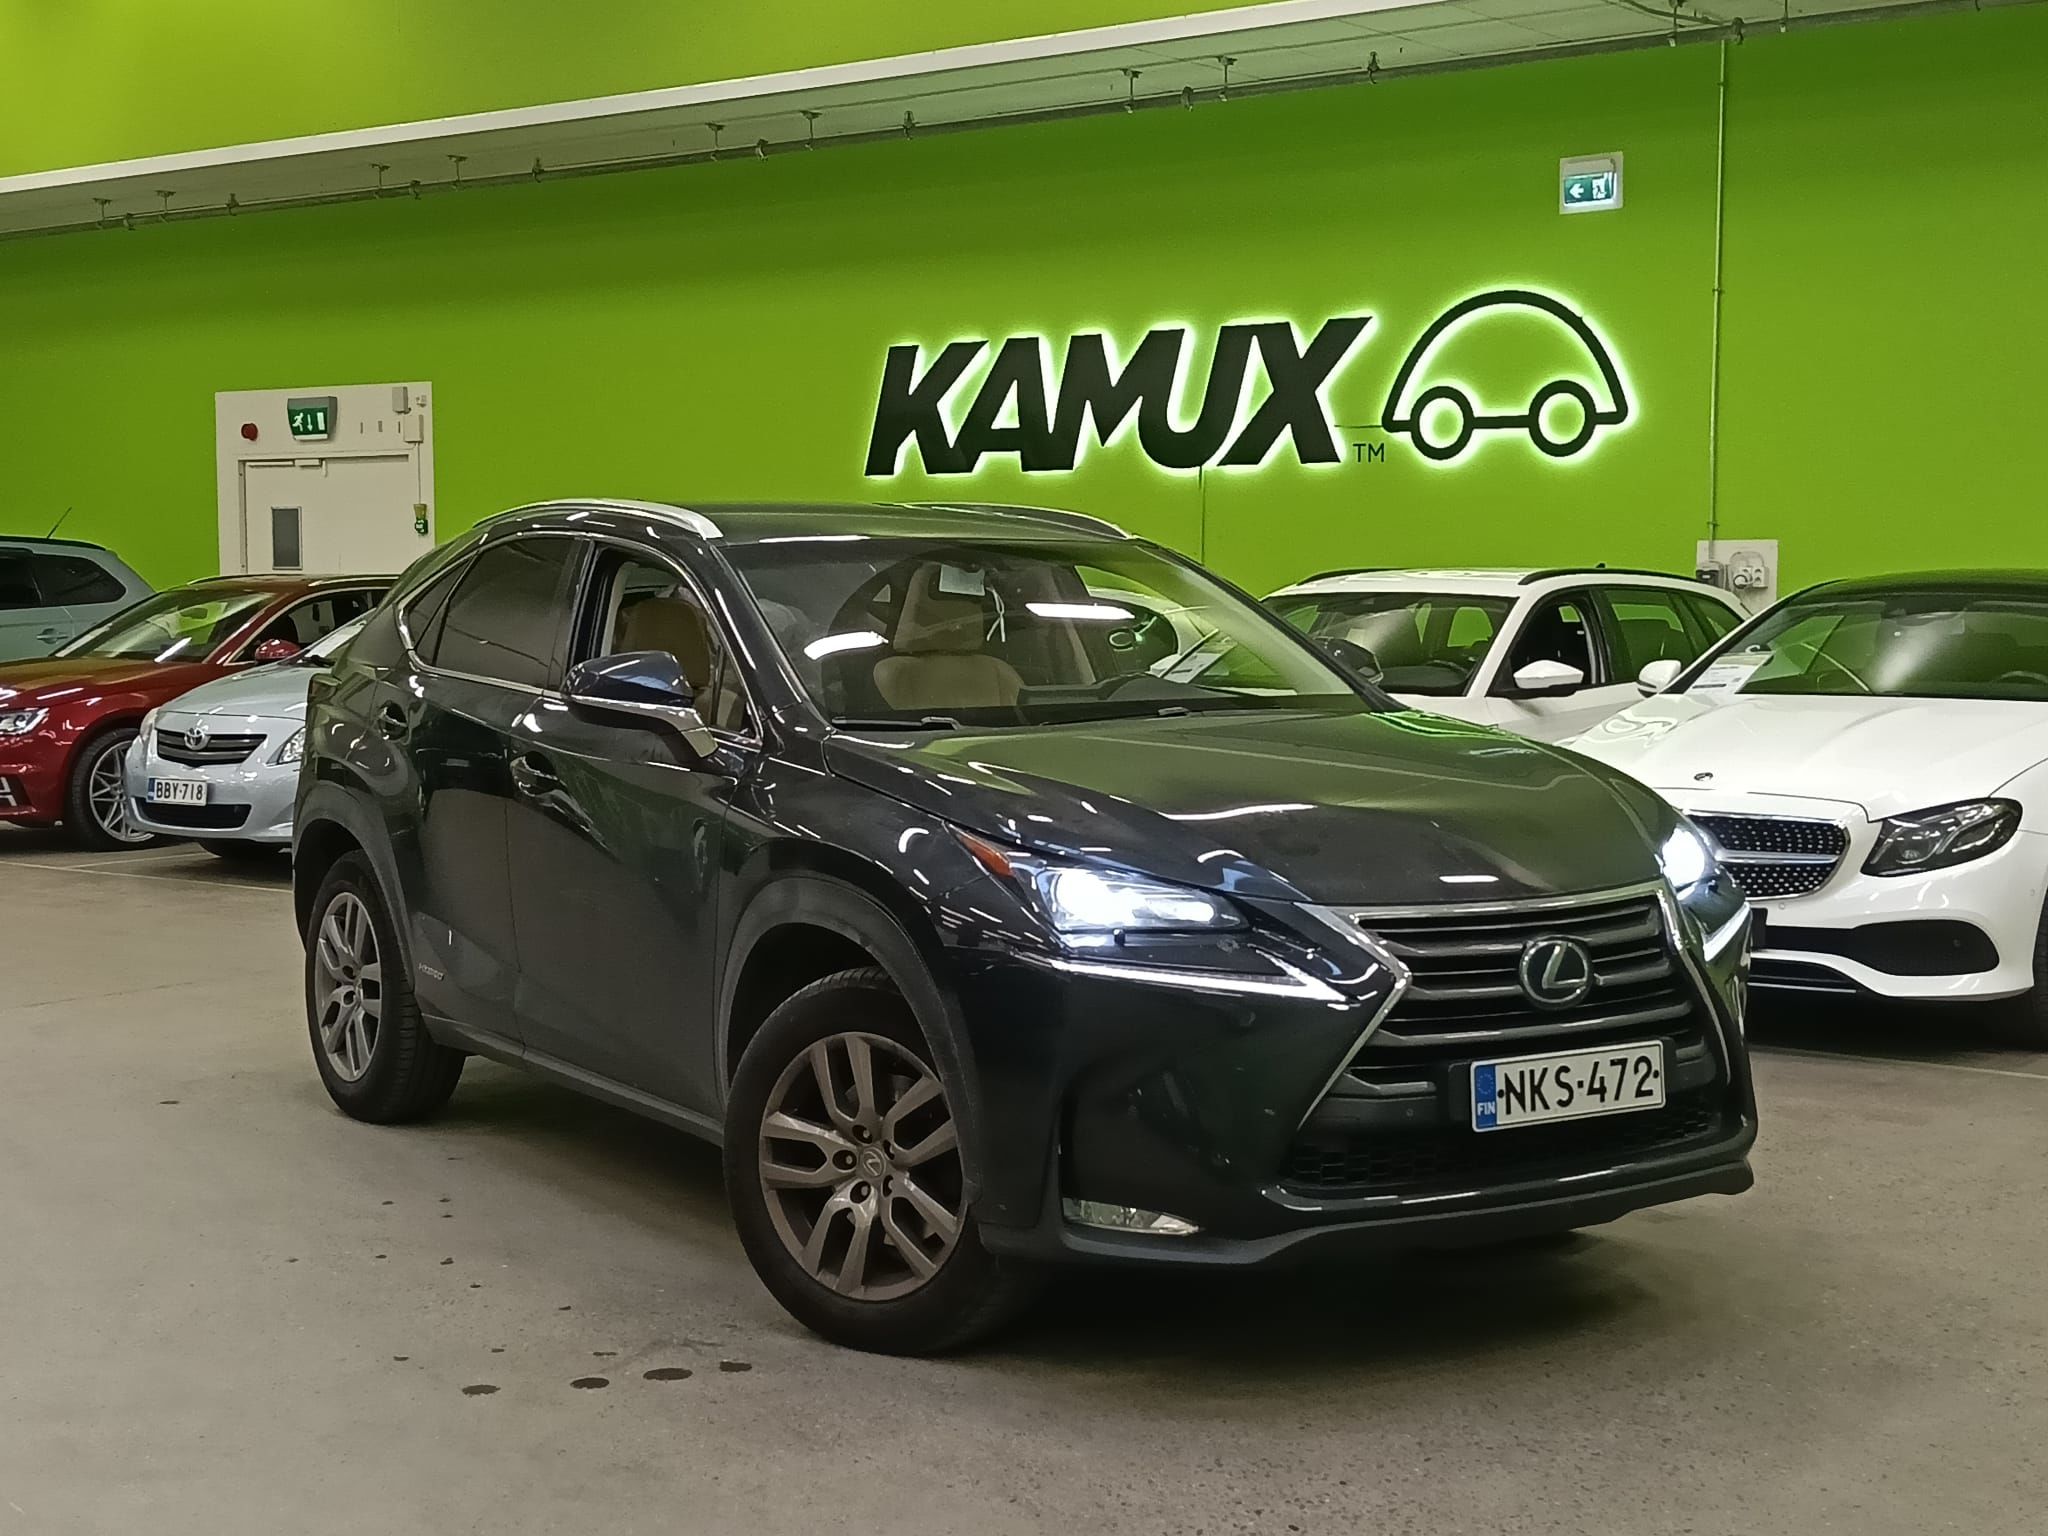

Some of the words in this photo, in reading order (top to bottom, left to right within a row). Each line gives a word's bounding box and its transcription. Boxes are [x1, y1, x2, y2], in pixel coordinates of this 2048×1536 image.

[864, 316, 1373, 476] KAMUX
[1352, 443, 1385, 463] TM
[156, 781, 204, 801] BBY-718
[1477, 1101, 1496, 1117] FIN
[1503, 1055, 1654, 1116] NKS-472
